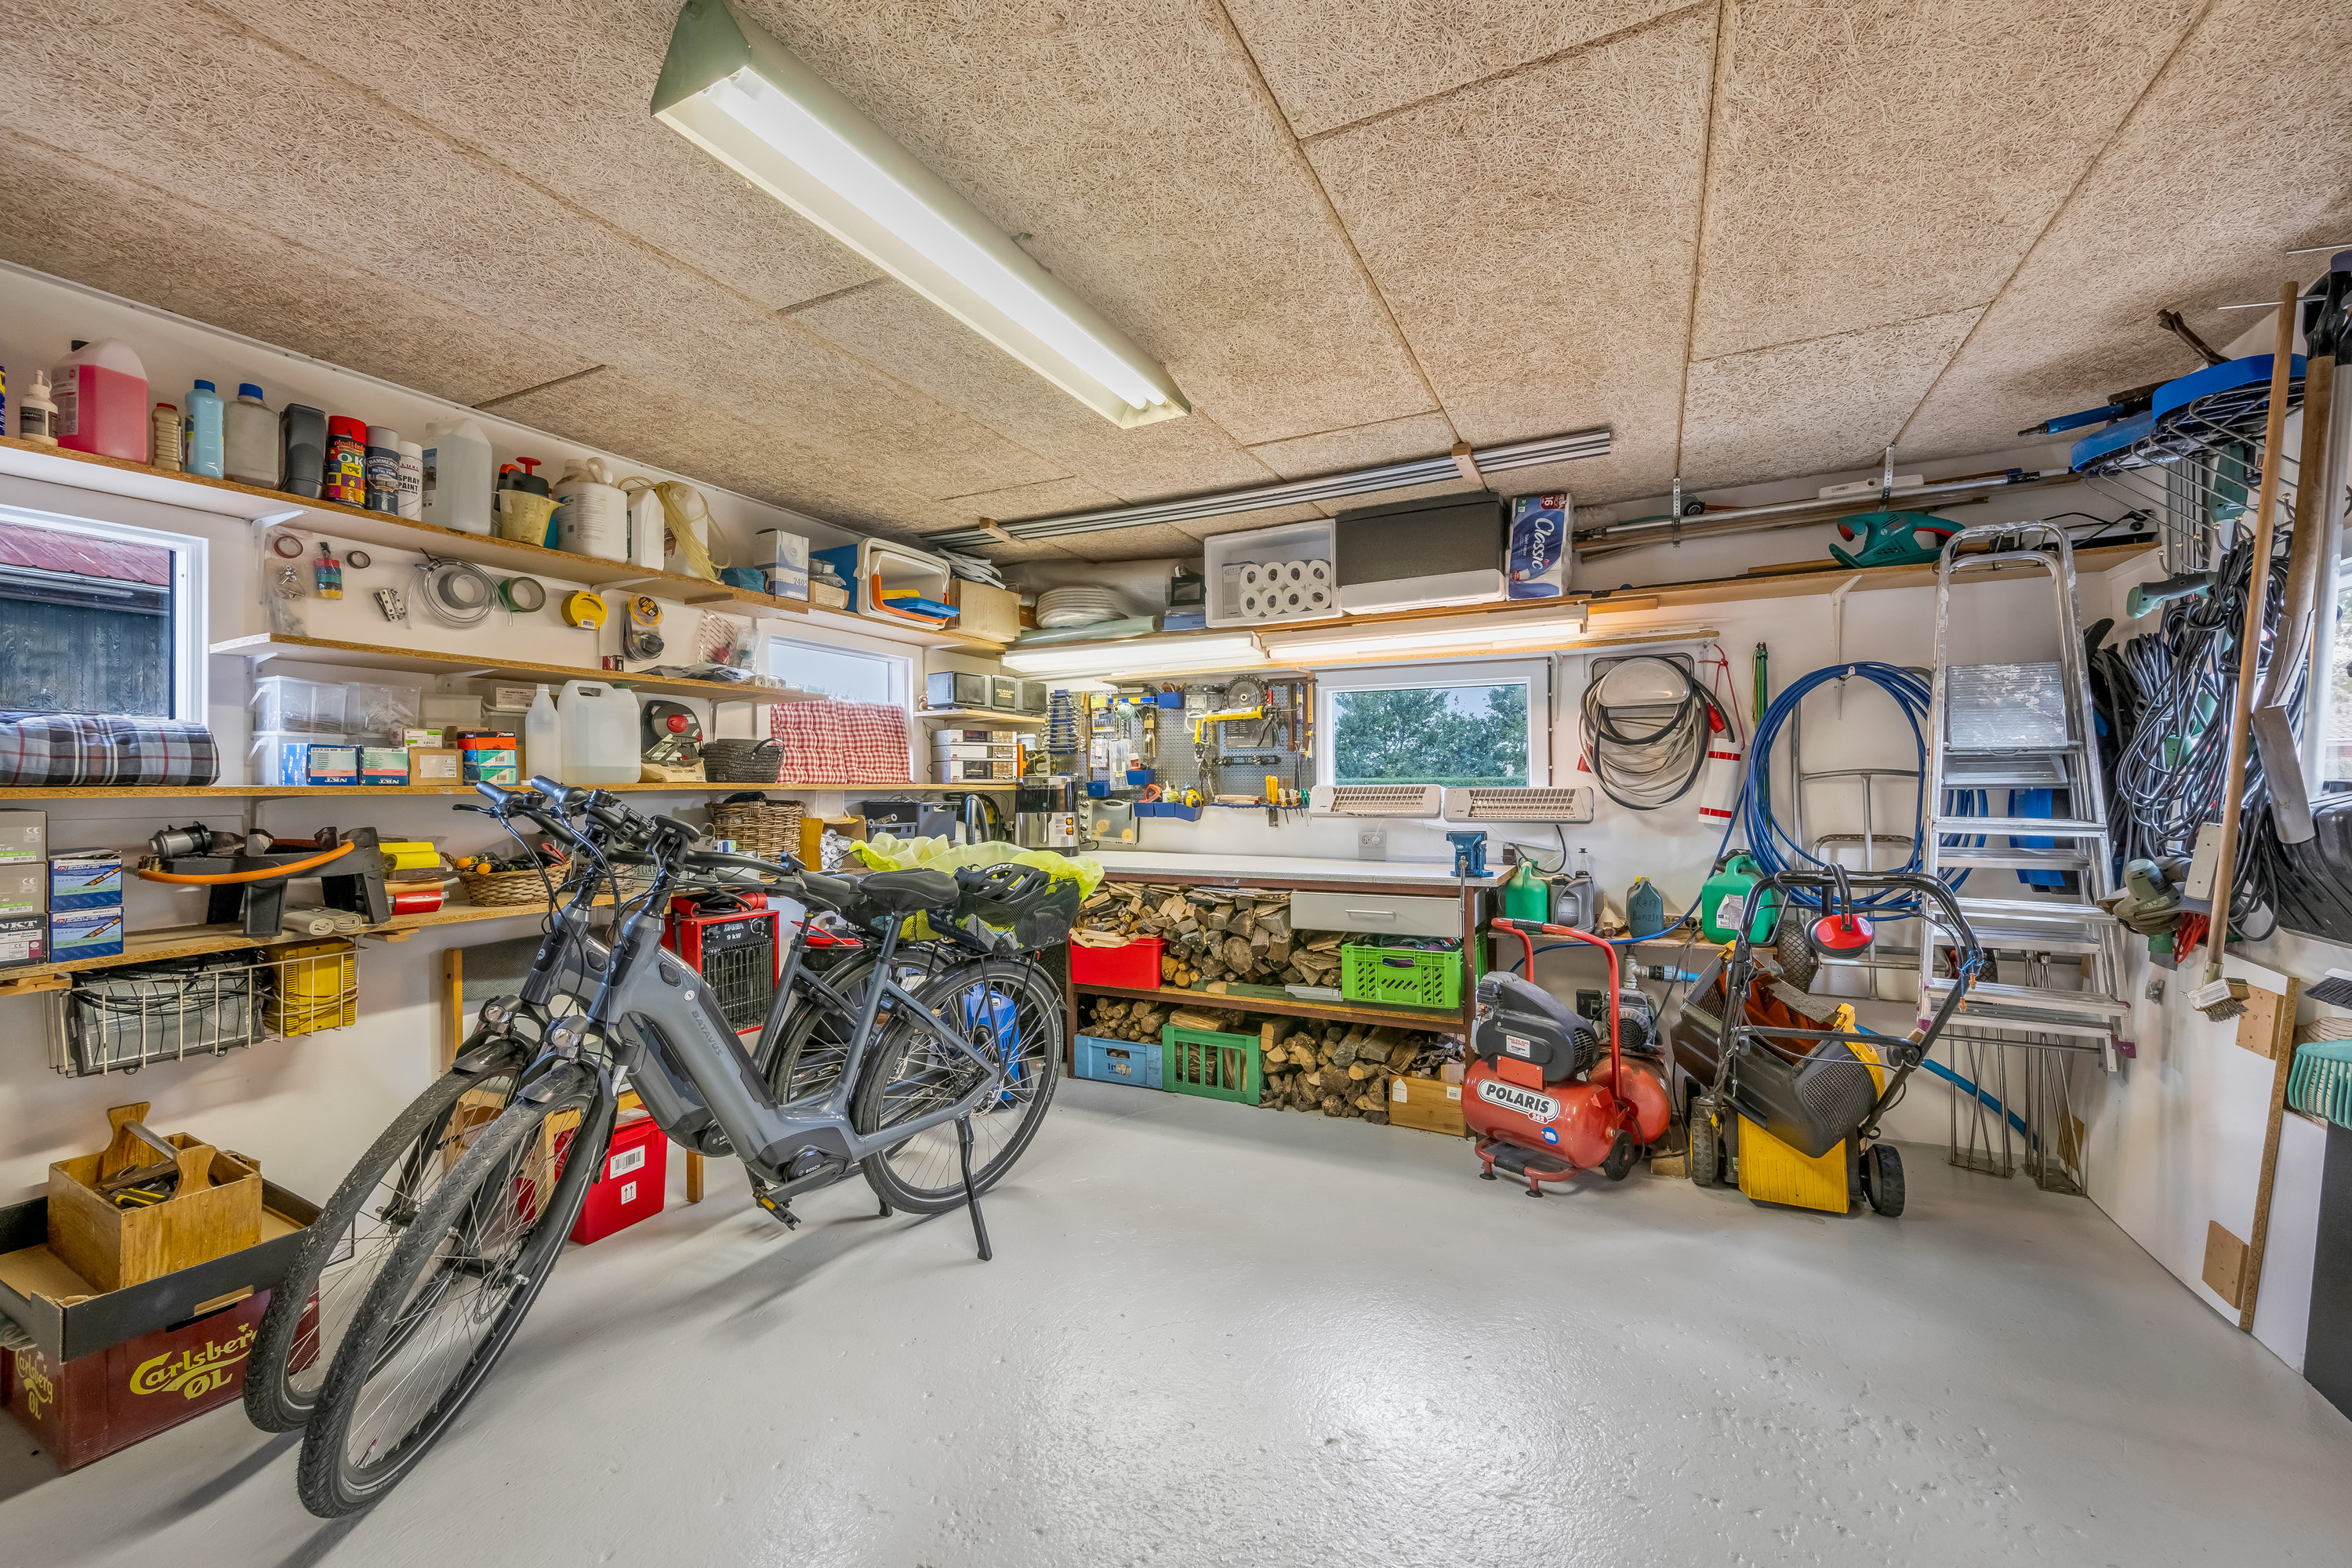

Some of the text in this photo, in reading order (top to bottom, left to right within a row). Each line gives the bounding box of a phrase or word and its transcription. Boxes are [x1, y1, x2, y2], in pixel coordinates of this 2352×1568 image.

[398, 474, 419, 485] SPRAY
[398, 482, 419, 492] PAINT
[1544, 496, 1553, 506] 16
[1531, 517, 1555, 570] Classic
[793, 577, 807, 587] 2405
[1636, 896, 1657, 908] Ren
[0, 920, 38, 931] NKT
[691, 1010, 723, 1056] BATAVUS
[1486, 1083, 1550, 1113] POLARIS
[1532, 1113, 1544, 1122] 262
[805, 1163, 821, 1174] BOSCH
[183, 1369, 233, 1400] ØL
[28, 1392, 42, 1421] ØL
